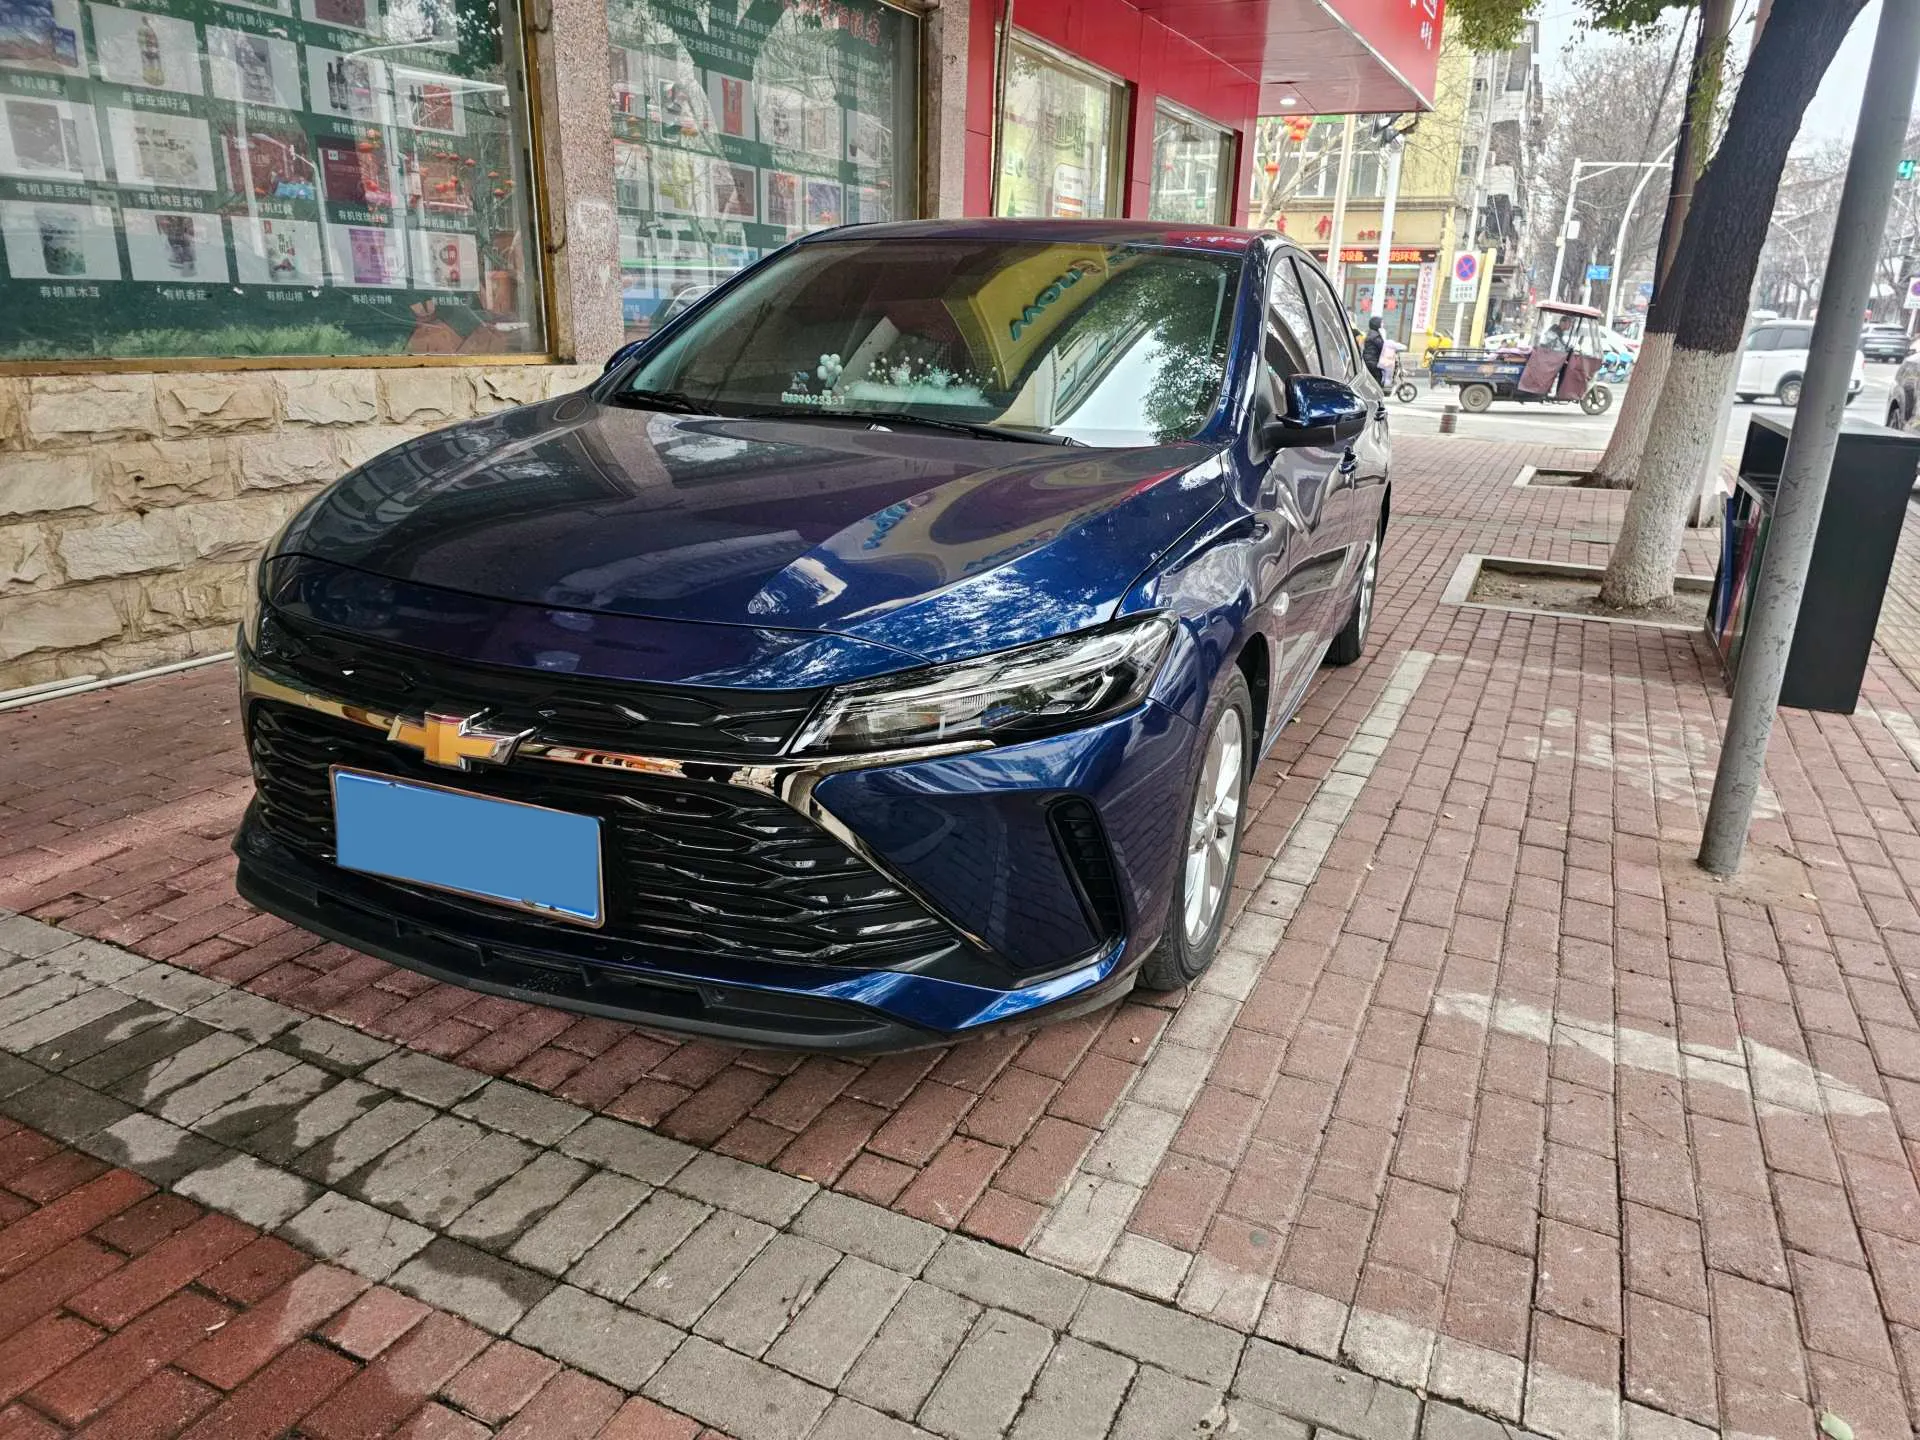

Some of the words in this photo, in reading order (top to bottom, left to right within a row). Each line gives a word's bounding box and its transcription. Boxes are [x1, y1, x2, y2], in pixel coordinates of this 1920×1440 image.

[40, 286, 101, 298] 有机黑木耳
